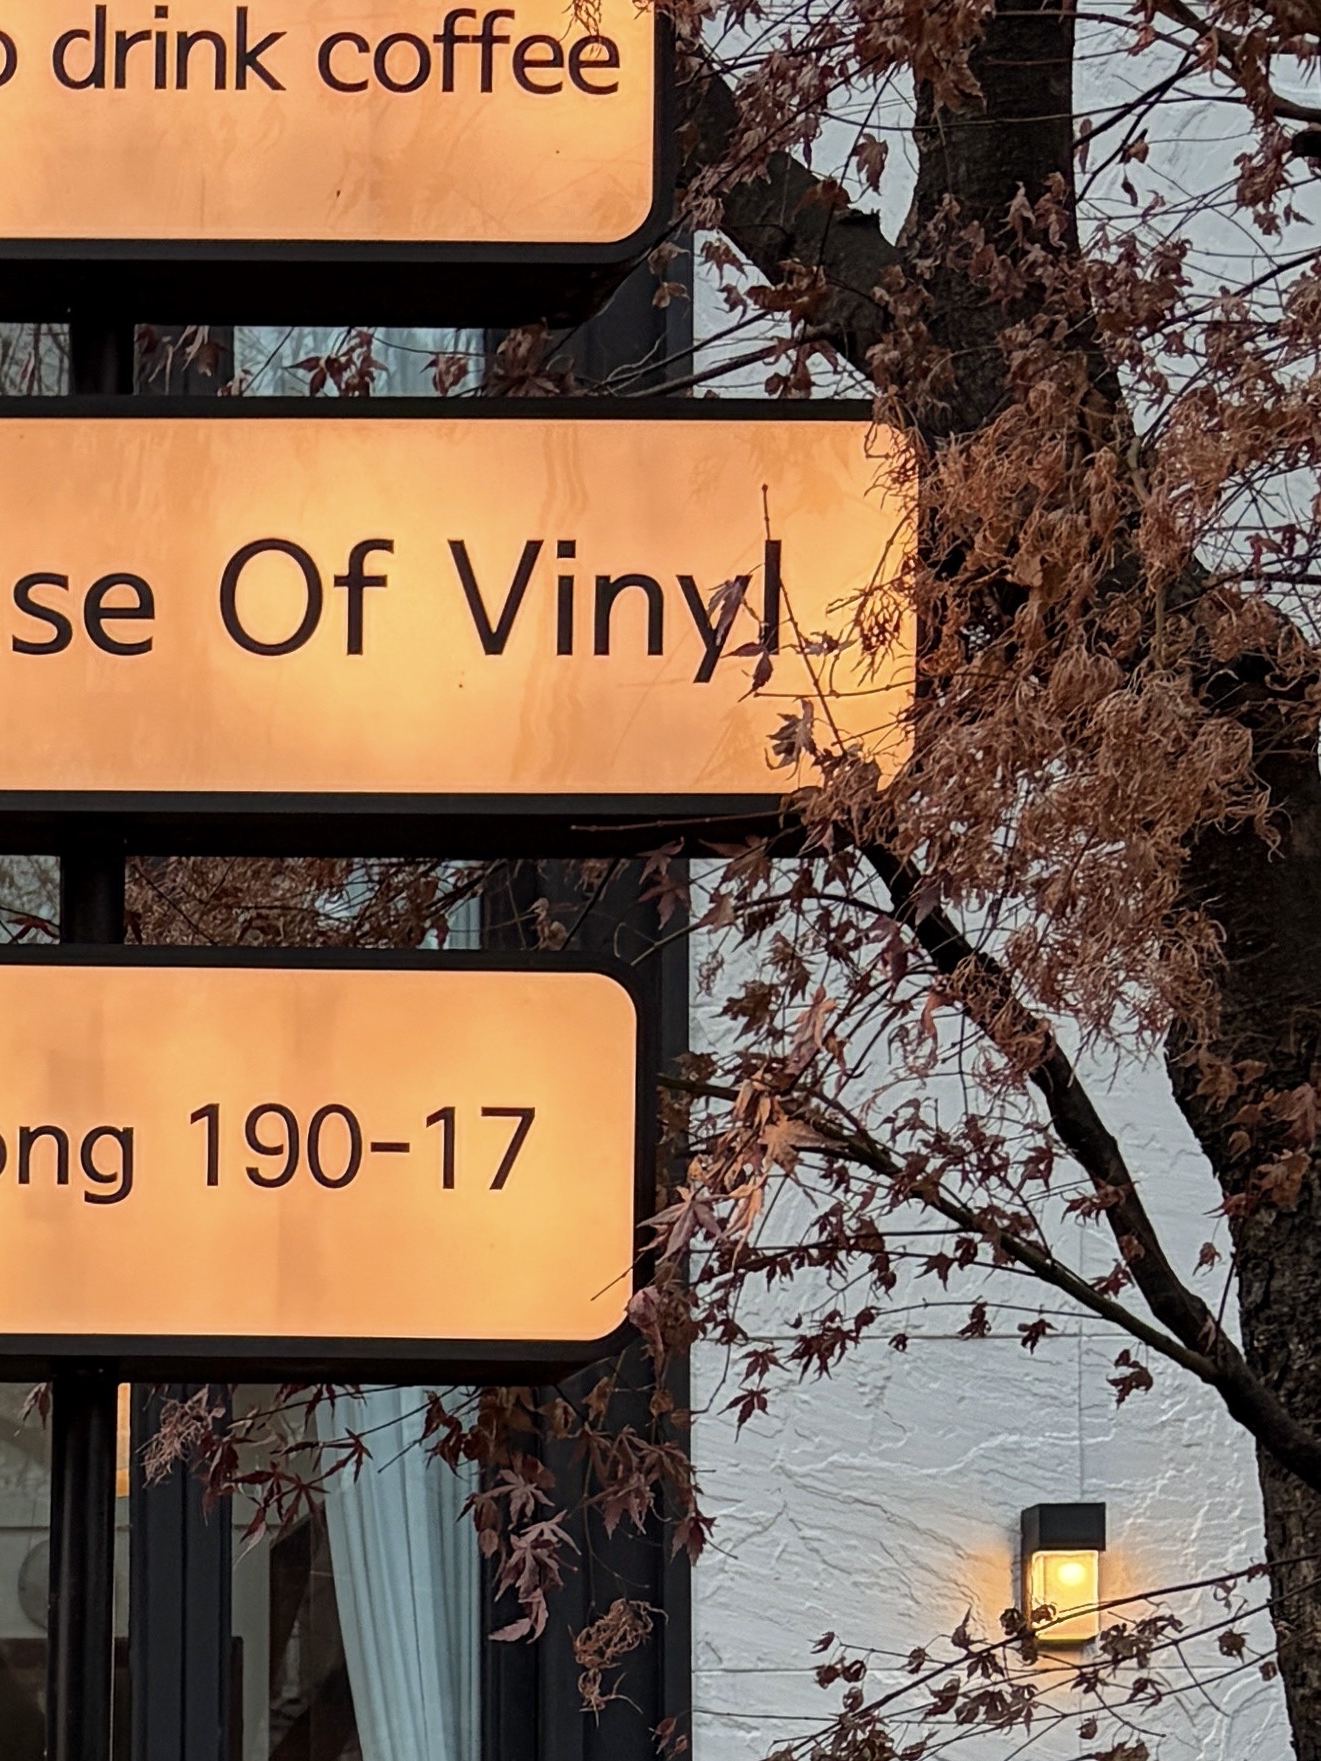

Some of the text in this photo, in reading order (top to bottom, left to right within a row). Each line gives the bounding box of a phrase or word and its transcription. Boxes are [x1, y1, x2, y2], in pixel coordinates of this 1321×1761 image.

[52, 4, 287, 91] drink
[317, 7, 621, 96] coffee
[219, 537, 394, 656] Of
[447, 539, 781, 684] Vinyl
[189, 1102, 537, 1190] 190-17
